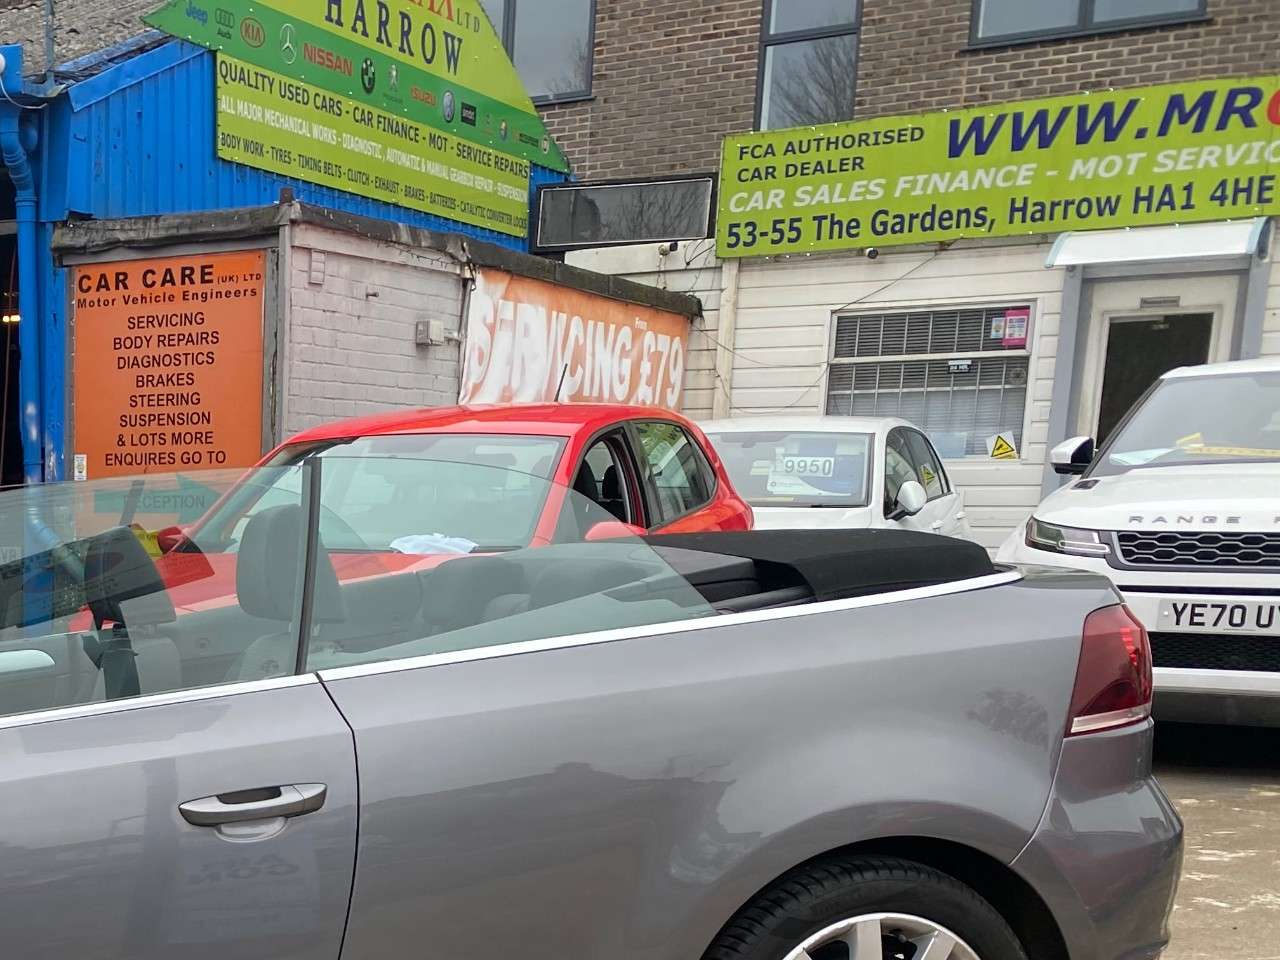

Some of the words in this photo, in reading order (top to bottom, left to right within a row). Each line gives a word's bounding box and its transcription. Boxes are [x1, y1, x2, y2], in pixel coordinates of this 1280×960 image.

[456, 8, 480, 33] LTD
[325, 0, 463, 76] HARROW
[303, 43, 353, 76] NISSAN
[219, 60, 275, 94] QUALITY
[279, 80, 310, 106] USED
[313, 93, 343, 117] CARS
[353, 106, 374, 129] CAR
[377, 115, 420, 143] FINANCE
[429, 132, 448, 153] MOT
[456, 142, 492, 167] SERVICE
[494, 154, 529, 179] REPAIRS
[221, 95, 235, 115] ALL
[237, 99, 263, 123] MAJOR
[264, 108, 311, 137] MECHANICAL
[312, 123, 337, 145] WORKS
[738, 143, 778, 161] FCA
[783, 125, 925, 157] AUTHORISED
[221, 131, 242, 148] BODY
[243, 138, 264, 158] WORK
[270, 146, 292, 165] TYRES
[298, 154, 322, 173] TIMING
[323, 162, 342, 179] BELTS
[347, 168, 370, 186] CLUTCH
[375, 176, 400, 194] EXHAUST
[404, 185, 425, 201] BRAKES
[737, 165, 780, 184] CAR
[784, 156, 865, 178] DEALER
[728, 189, 790, 213] CAR
[793, 179, 885, 209] SALES
[893, 162, 1037, 200] FINANCE
[1068, 152, 1148, 182] MOT
[726, 215, 803, 250] 53-55
[813, 211, 861, 242] The
[871, 202, 997, 236] Gardens,
[1008, 191, 1121, 225] Harrow
[1132, 181, 1195, 216] HA1
[1209, 174, 1276, 207] 4HE
[78, 271, 129, 294] CAR
[142, 264, 214, 290] CARE
[243, 273, 262, 282] LTD
[77, 297, 117, 309] Motor
[123, 291, 175, 305] Vehicle
[182, 288, 257, 303] Engineers
[127, 311, 205, 330] SERVICING
[113, 334, 153, 351] BODY
[157, 331, 220, 348] REPAIRS
[117, 351, 215, 370] DIAGNOSTICS
[136, 372, 195, 389] BRAKES
[129, 391, 201, 408] STEERING
[119, 411, 211, 428] SUSPENSION
[117, 434, 126, 447] &
[130, 432, 166, 447] LOTS
[171, 430, 213, 446] MORE
[105, 451, 176, 467] ENQUIRES
[180, 451, 202, 465] GO
[208, 450, 226, 464] TO
[785, 459, 832, 476] 9950
[1128, 515, 1241, 524] RANGE
[1172, 602, 1247, 628] YE70
